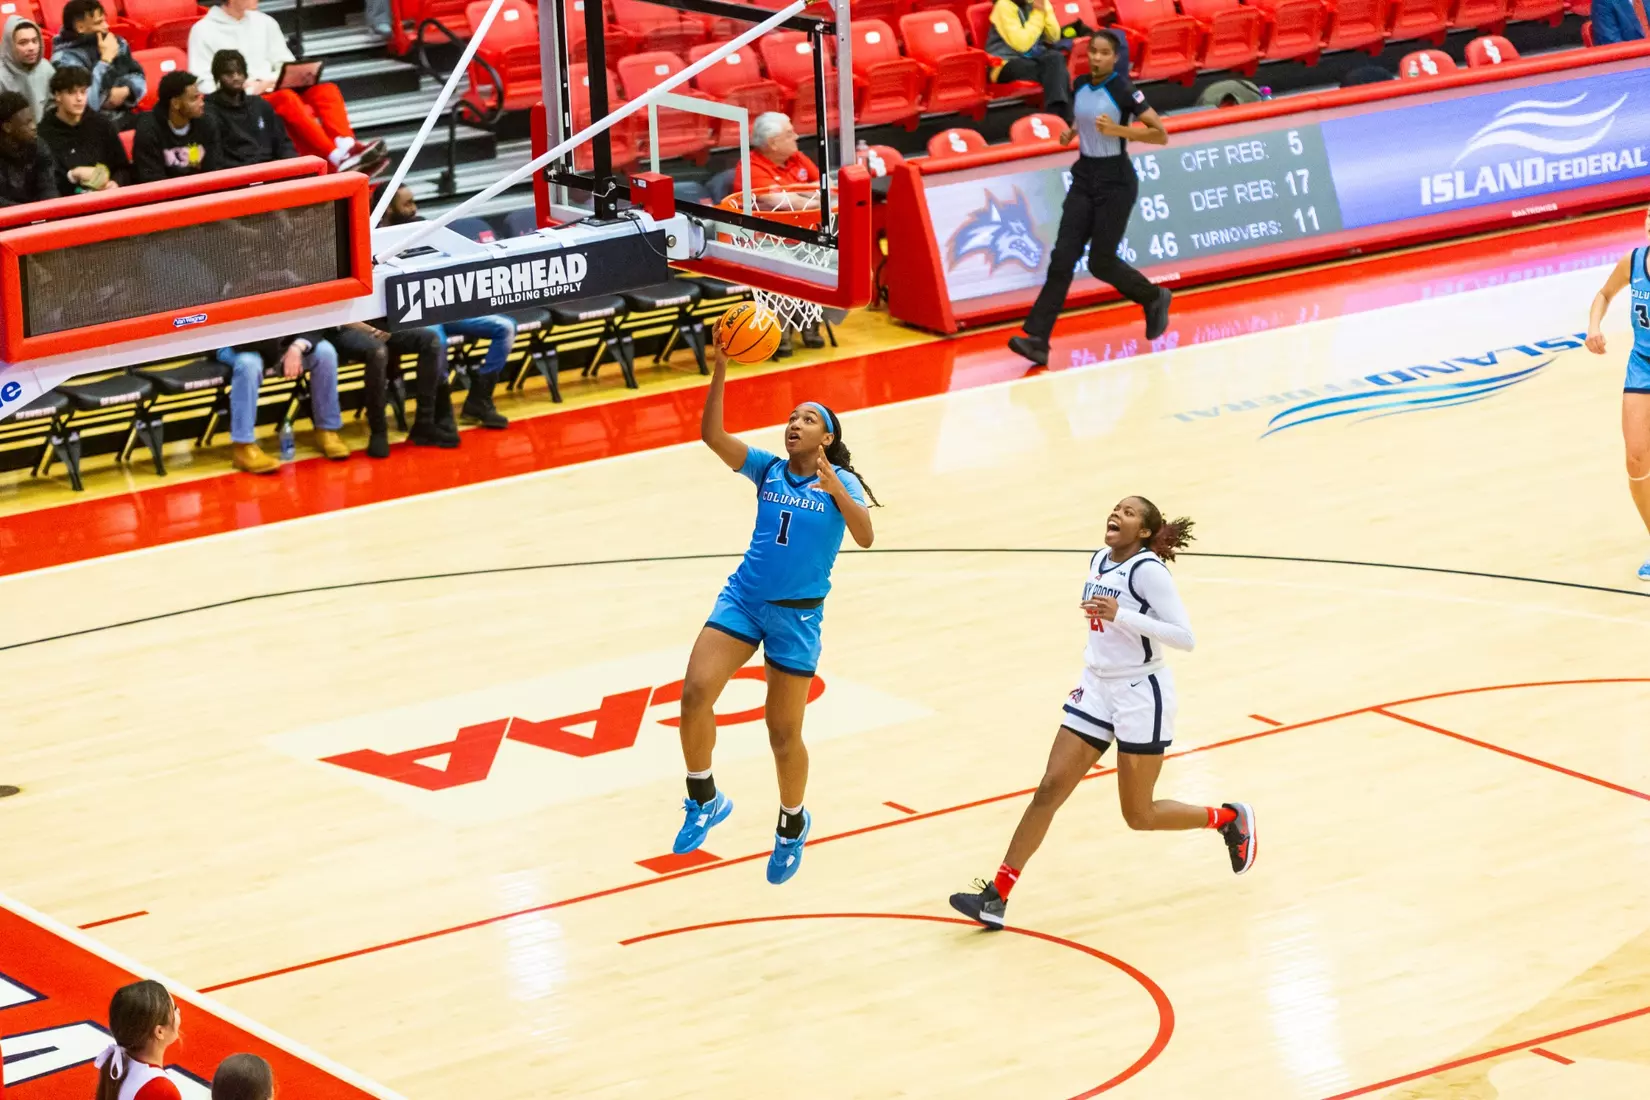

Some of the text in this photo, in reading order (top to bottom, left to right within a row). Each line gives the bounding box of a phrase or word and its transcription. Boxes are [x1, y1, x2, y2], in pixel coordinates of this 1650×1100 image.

[1180, 131, 1303, 172] OFF REB: 5
[1190, 169, 1310, 212] DEF REB: 17
[1420, 147, 1648, 205] ISLAND FEDERAL
[1139, 194, 1170, 222] 85
[1149, 231, 1179, 260] 46
[1190, 206, 1320, 250] TURNOVERS: 11
[424, 253, 588, 309] RIVERHEAD
[490, 282, 582, 307] BUILDING SUPPLY
[725, 304, 750, 329] NCAA
[763, 491, 825, 513] COLUMBIA
[776, 510, 793, 546] 1
[316, 665, 827, 791] CAA
